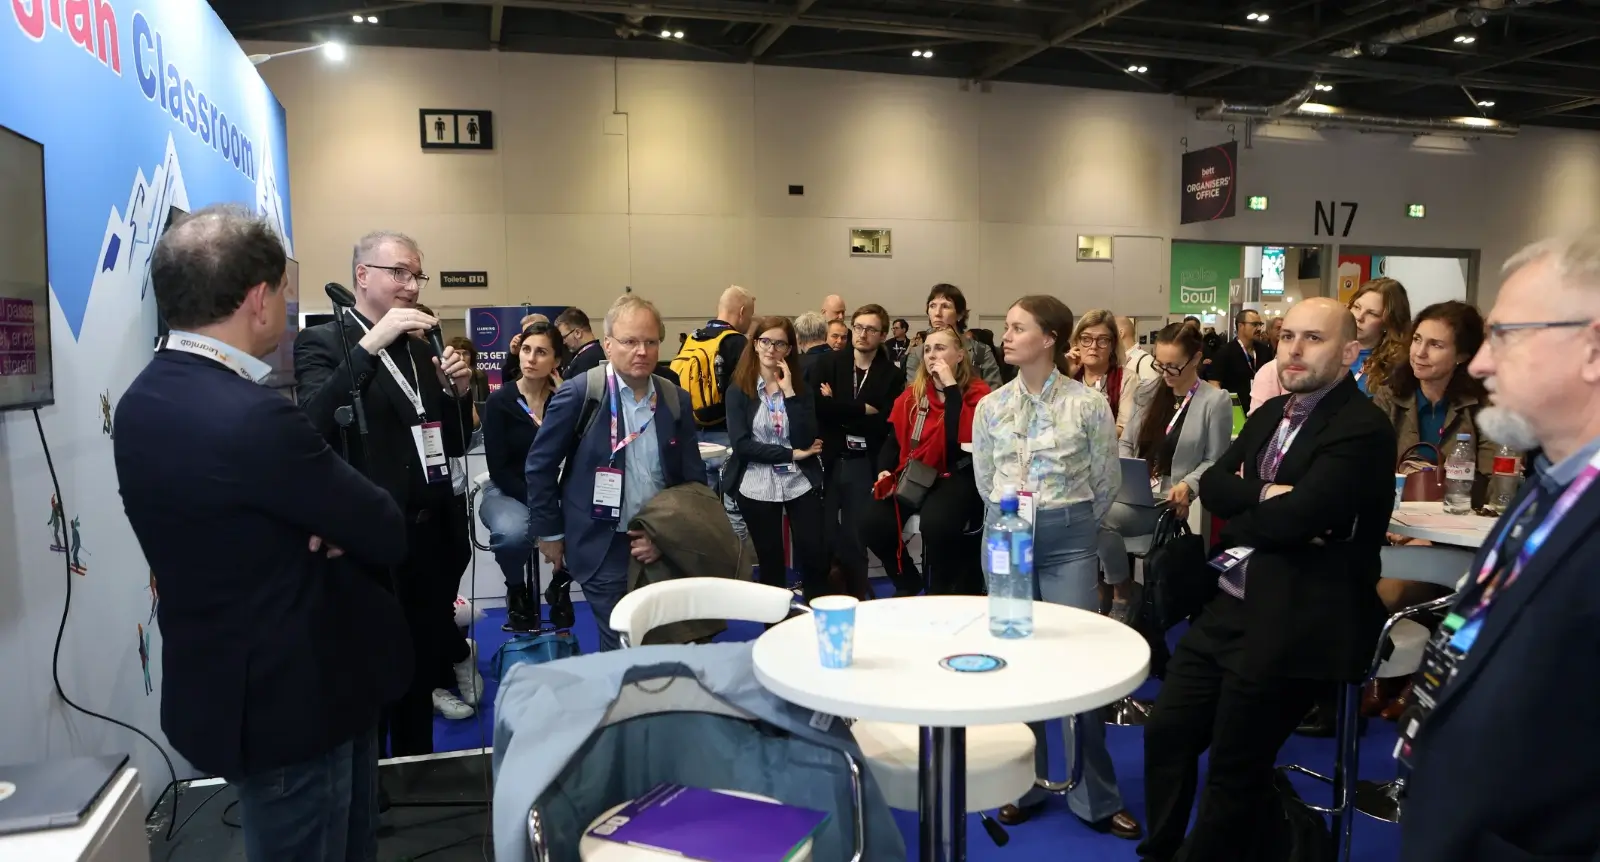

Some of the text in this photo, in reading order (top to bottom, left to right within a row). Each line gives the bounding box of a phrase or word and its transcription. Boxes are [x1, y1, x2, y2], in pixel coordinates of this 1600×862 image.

[132, 10, 256, 184] Classroom
[1202, 167, 1215, 176] bett
[1187, 177, 1231, 193] ORGANISERS'
[1196, 189, 1220, 200] OFFICE
[1314, 201, 1359, 237] N7
[443, 275, 466, 283] Toilets
[1181, 286, 1217, 304] bowl
[1230, 285, 1240, 297] N7
[180, 339, 219, 356] Learnlab
[490, 351, 507, 360] GET
[476, 362, 502, 371] SOCIAL
[489, 383, 502, 391] THE
